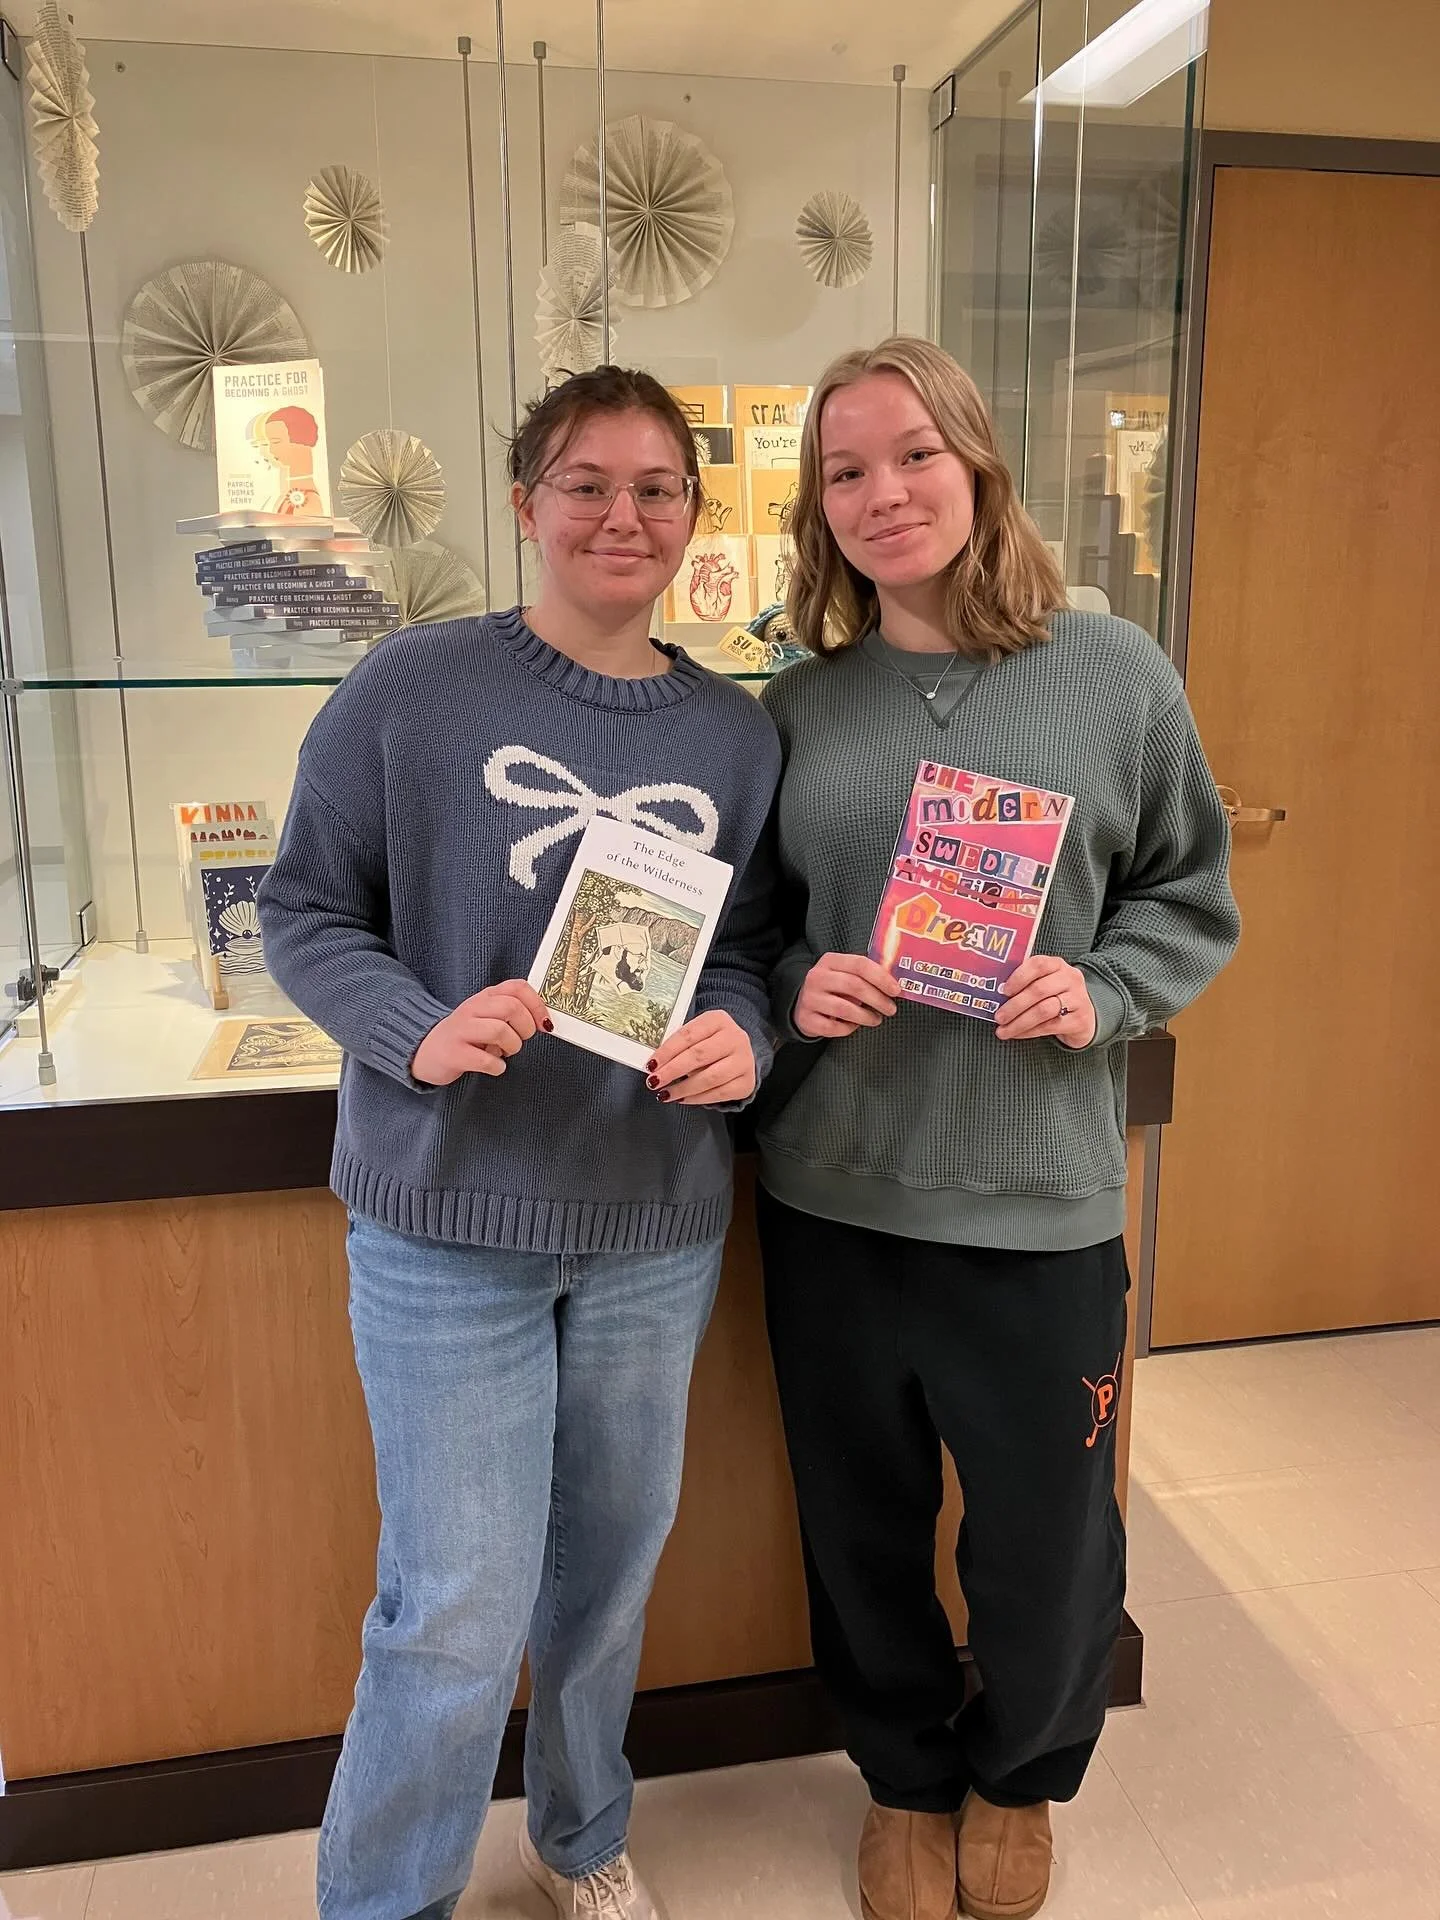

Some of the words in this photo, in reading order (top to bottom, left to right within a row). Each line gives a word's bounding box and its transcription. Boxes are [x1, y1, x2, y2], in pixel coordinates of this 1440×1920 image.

[224, 373, 281, 387] PRACTICE
[286, 371, 308, 384] FOR
[224, 388, 270, 398] BECOMING
[274, 388, 279, 396] A
[282, 385, 308, 396] GHOST
[754, 436, 798, 449] You're
[224, 572, 250, 580] PRACTICE
[251, 572, 261, 580] FOR
[264, 570, 291, 578] BECOMING
[298, 568, 316, 576] GHOST
[233, 583, 262, 592] PRACTICE
[263, 582, 274, 590] FOR
[277, 581, 307, 589] BECOMING
[316, 580, 334, 588] GHOST
[283, 606, 310, 614] PRACTICE
[310, 606, 322, 614] FOR
[322, 606, 350, 614] BECOMING
[732, 635, 752, 650] SU
[633, 840, 655, 856] The
[657, 850, 686, 867] Edge
[606, 852, 621, 862] of
[621, 856, 640, 870] the
[643, 863, 704, 896] Wilderness
[1097, 1384, 1113, 1420] P
